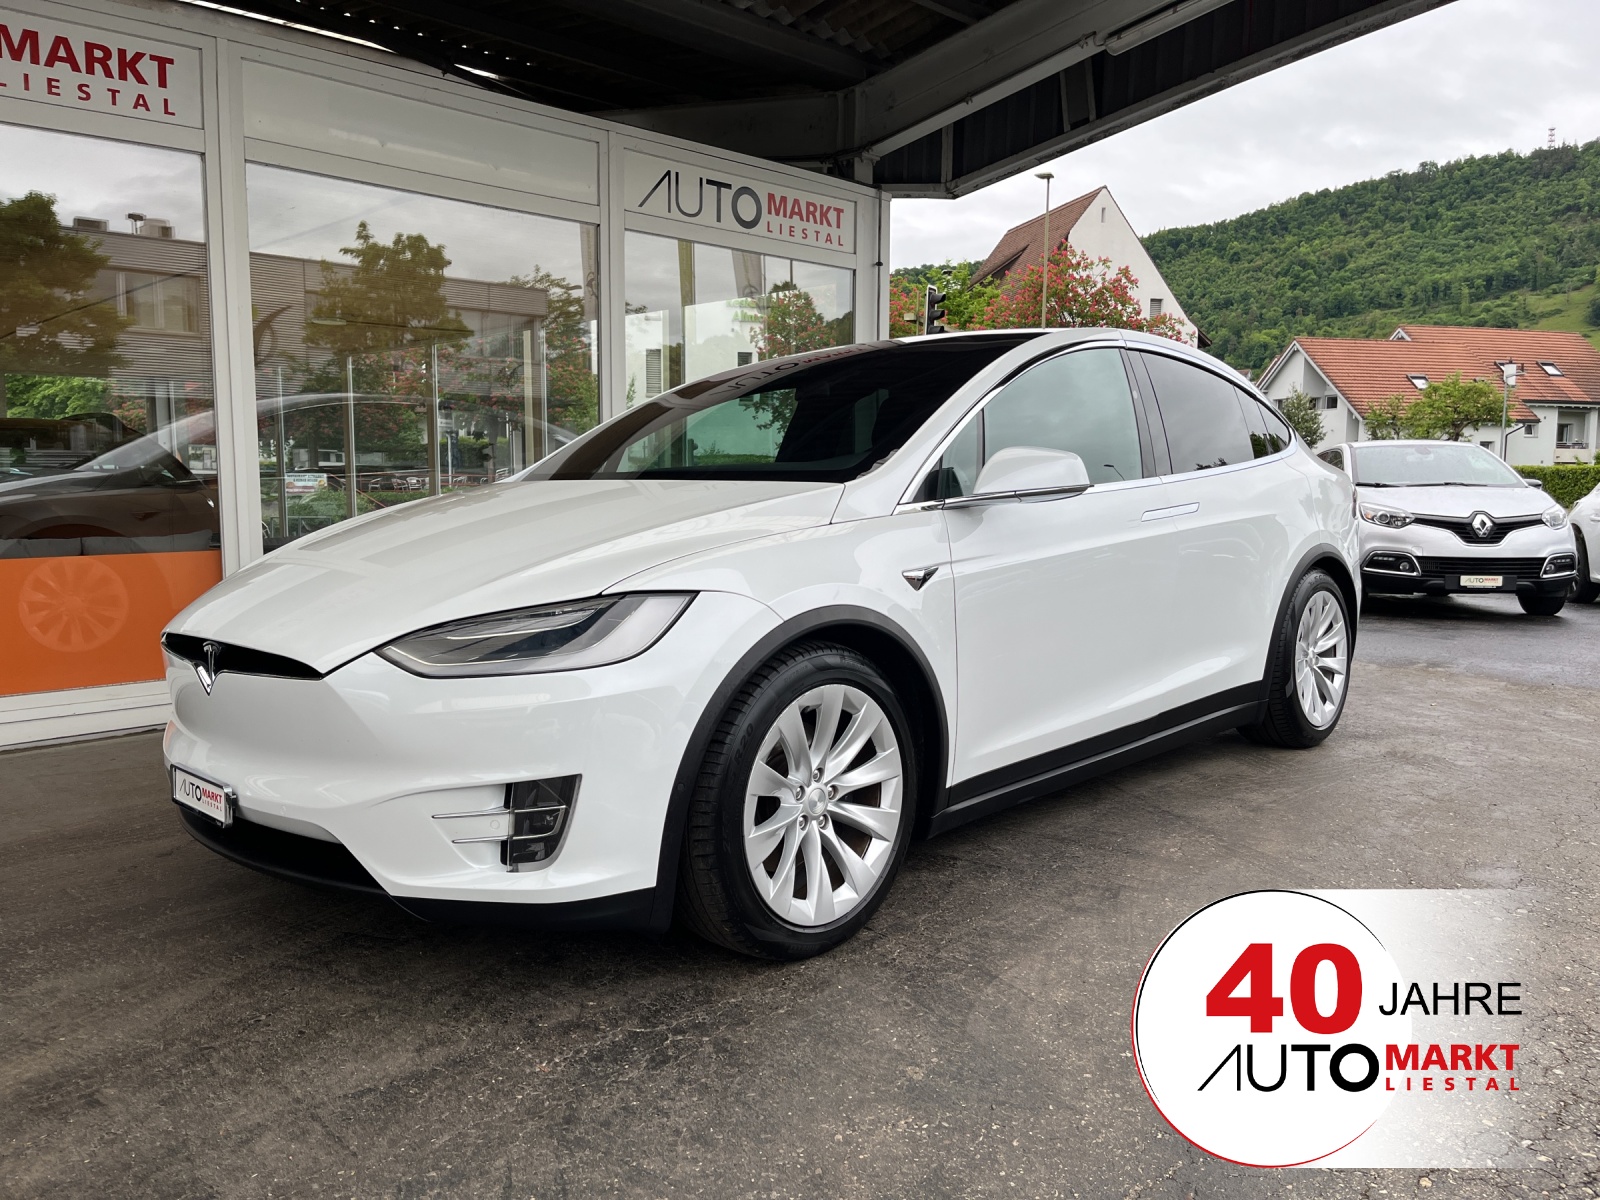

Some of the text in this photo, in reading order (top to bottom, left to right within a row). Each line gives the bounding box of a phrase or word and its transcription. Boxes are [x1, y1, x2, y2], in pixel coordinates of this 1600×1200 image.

[0, 23, 175, 89] MARKT
[0, 72, 176, 116] IESTAL
[637, 169, 844, 230] AUTO MARKT
[766, 221, 844, 247] LIESTAL
[180, 778, 222, 804] AUTO MARKT
